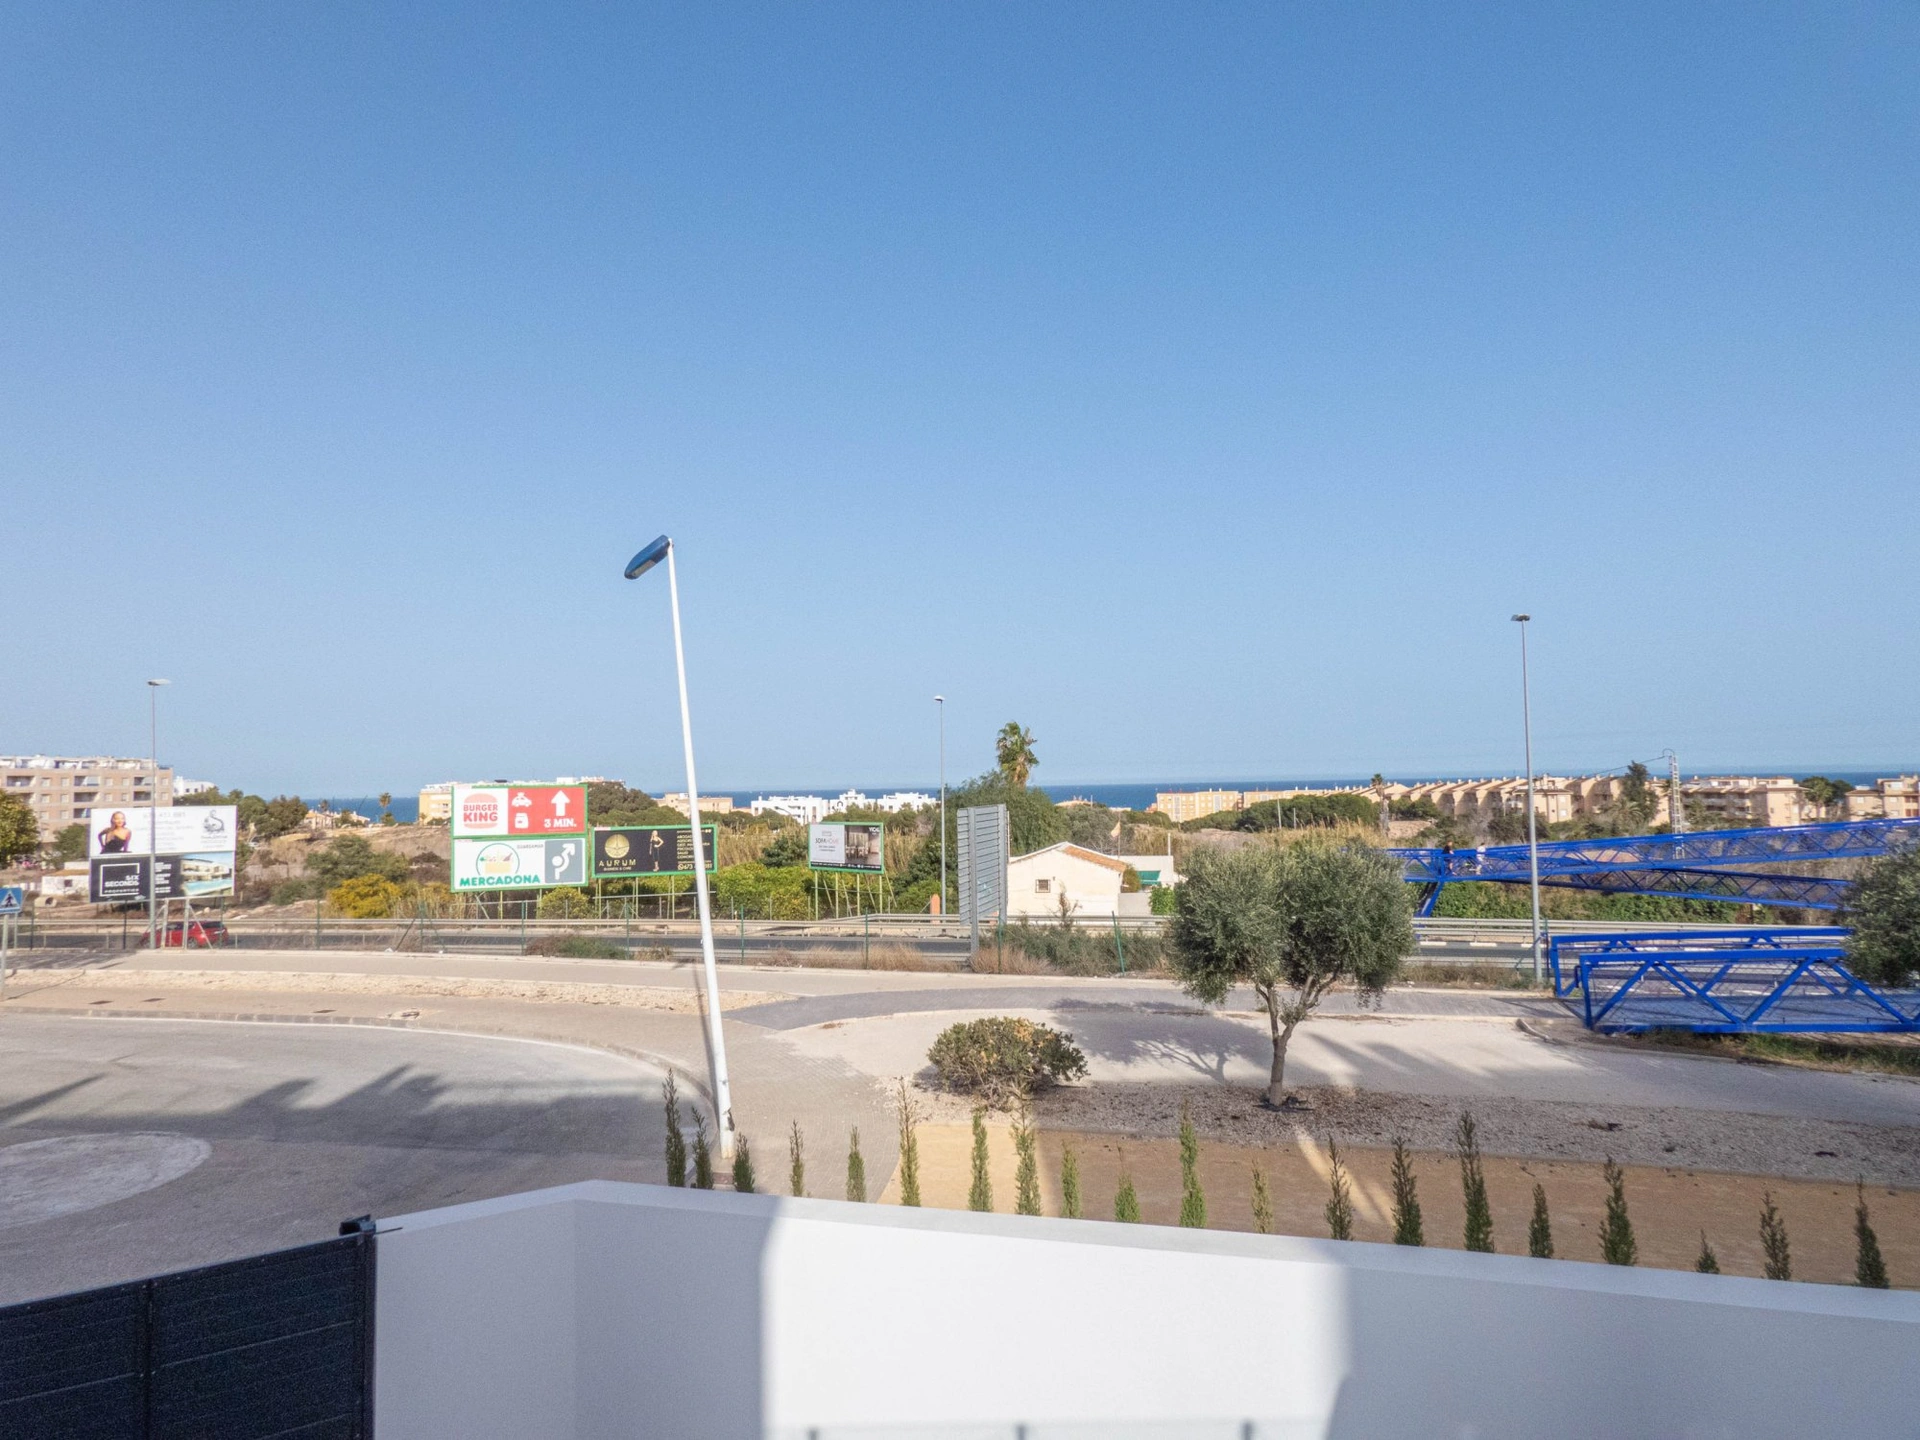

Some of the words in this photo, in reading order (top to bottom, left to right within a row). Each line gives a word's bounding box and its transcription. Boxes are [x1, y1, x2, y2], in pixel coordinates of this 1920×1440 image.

[463, 804, 498, 812] BURGER
[463, 812, 498, 822] KING
[544, 819, 551, 828] 3
[553, 818, 577, 828] MIN.
[599, 859, 637, 867] AURUM
[459, 874, 541, 887] MERCADONA
